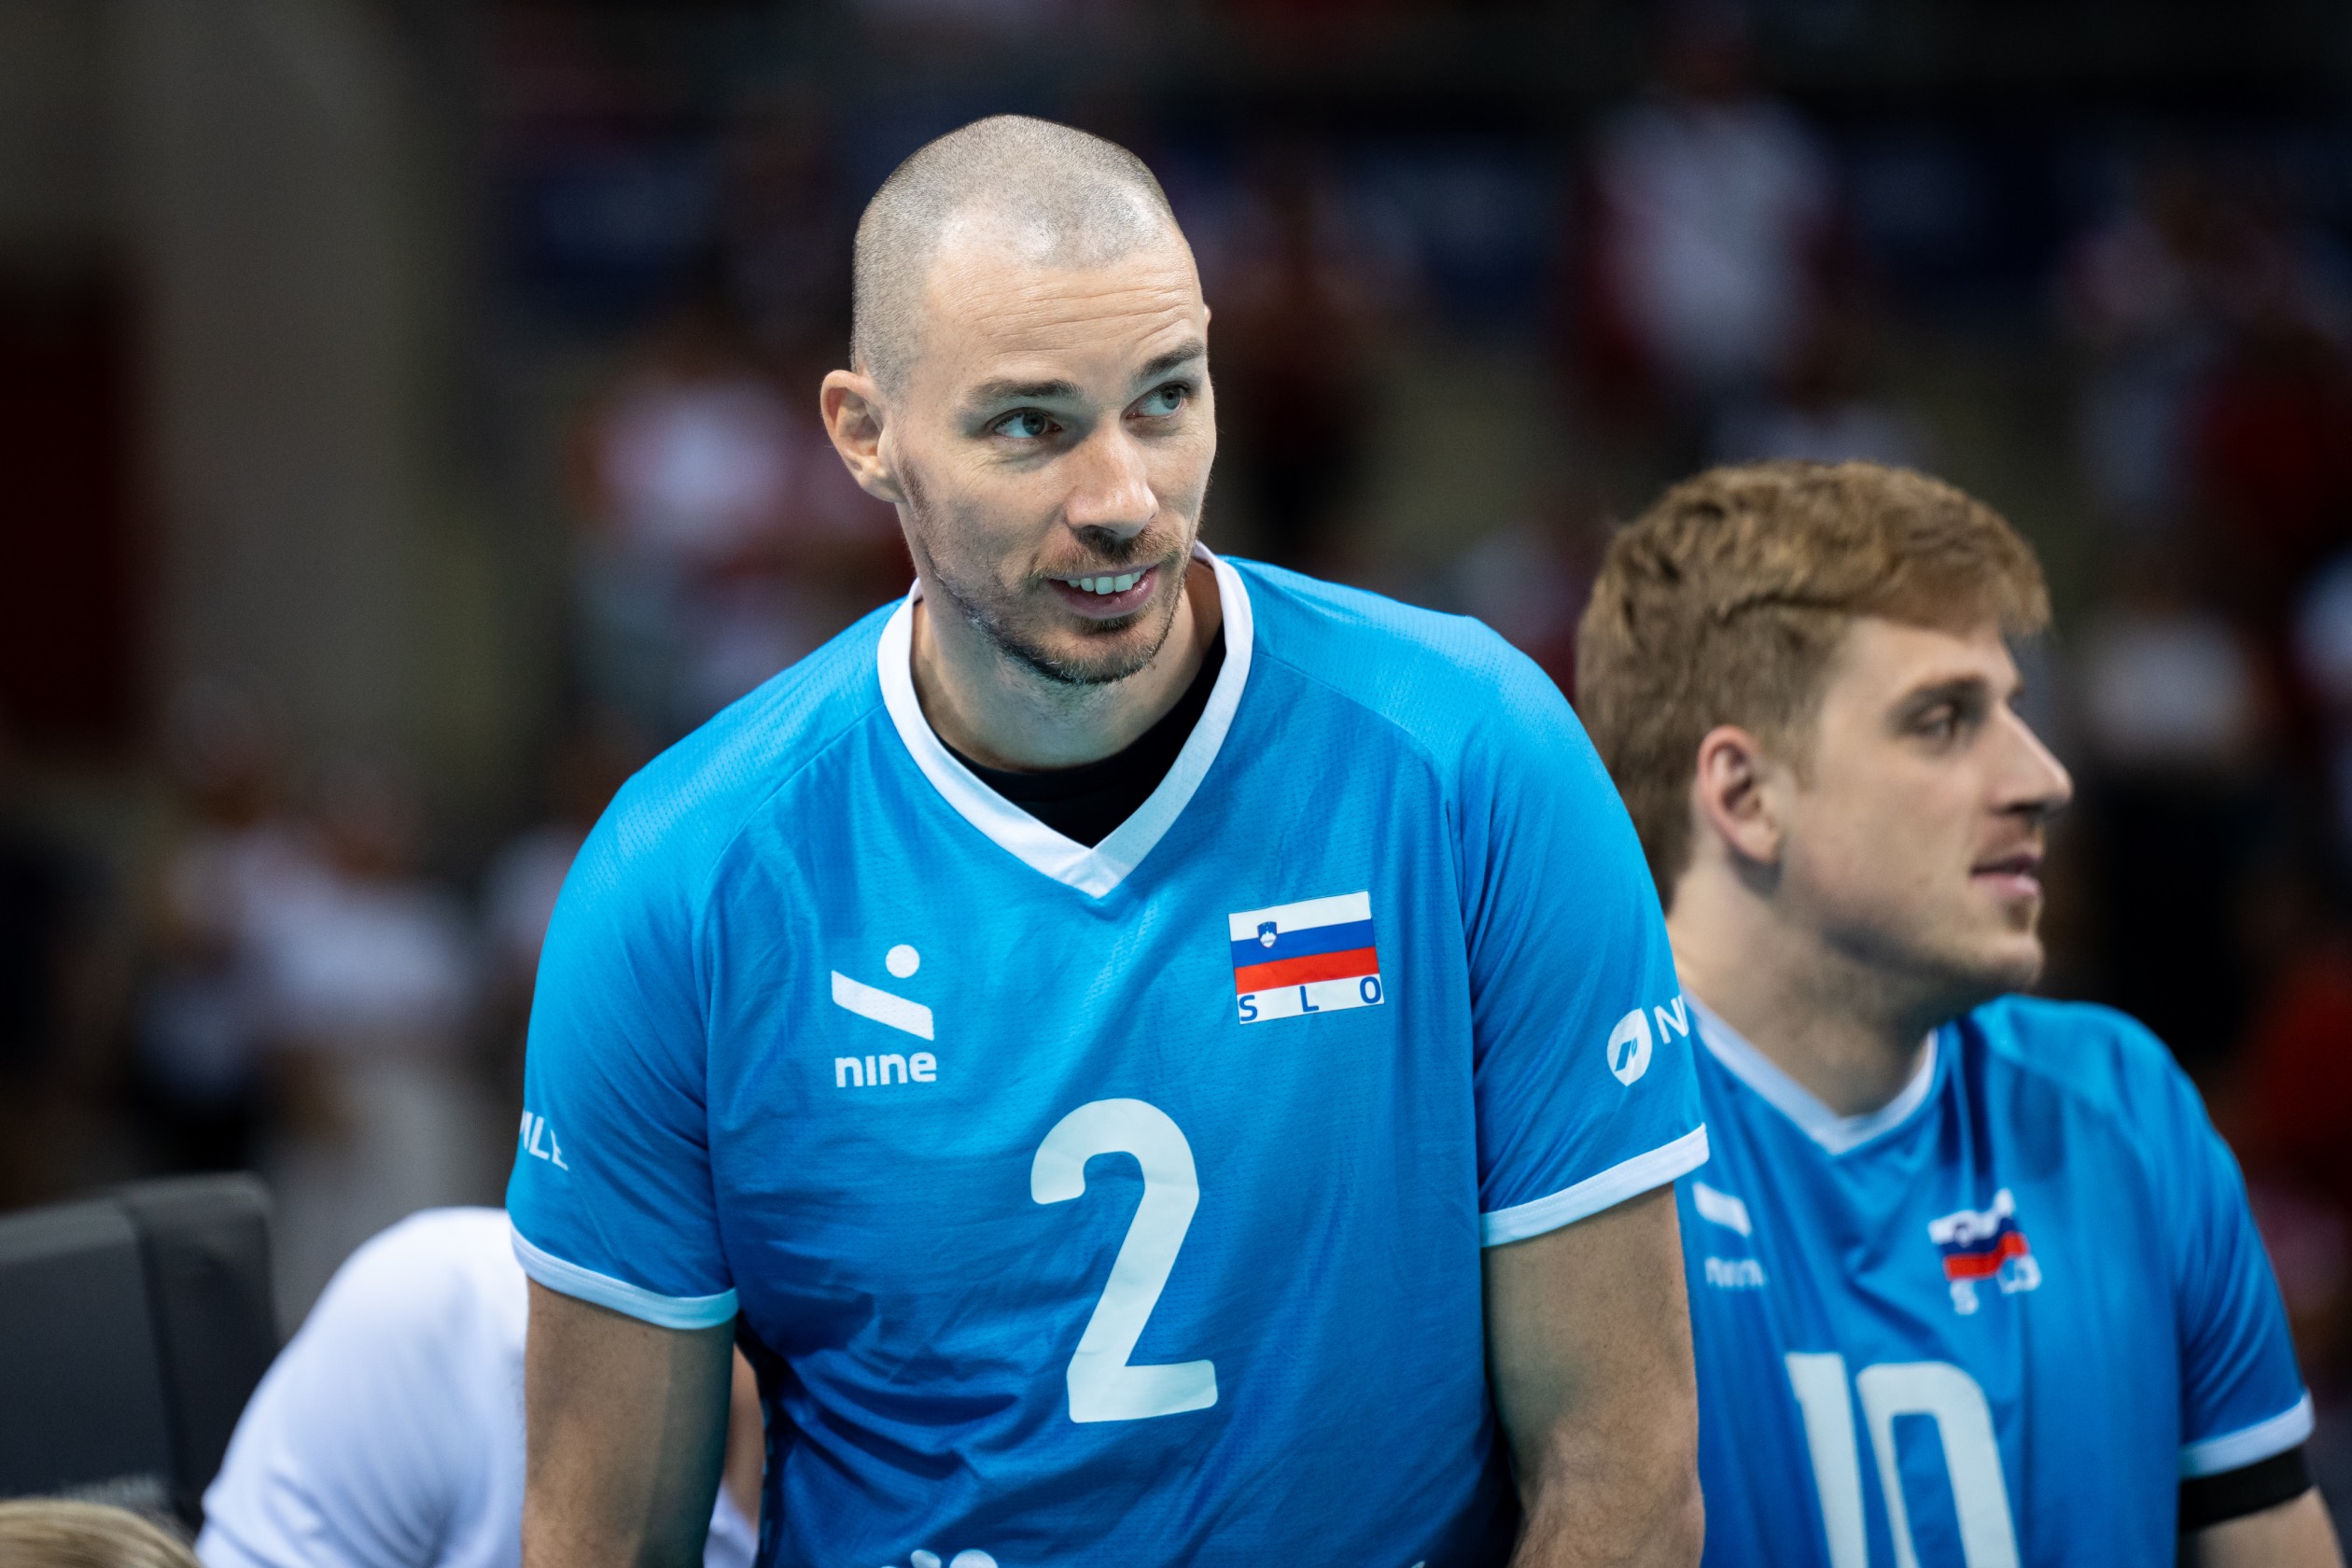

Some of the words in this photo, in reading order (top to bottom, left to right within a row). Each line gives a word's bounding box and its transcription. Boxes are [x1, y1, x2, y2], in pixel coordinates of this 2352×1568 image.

[1239, 976, 1381, 1022] SLO
[835, 1052, 936, 1086] nine
[1030, 1098, 1217, 1423] 2
[1785, 1352, 2021, 1568] 10
